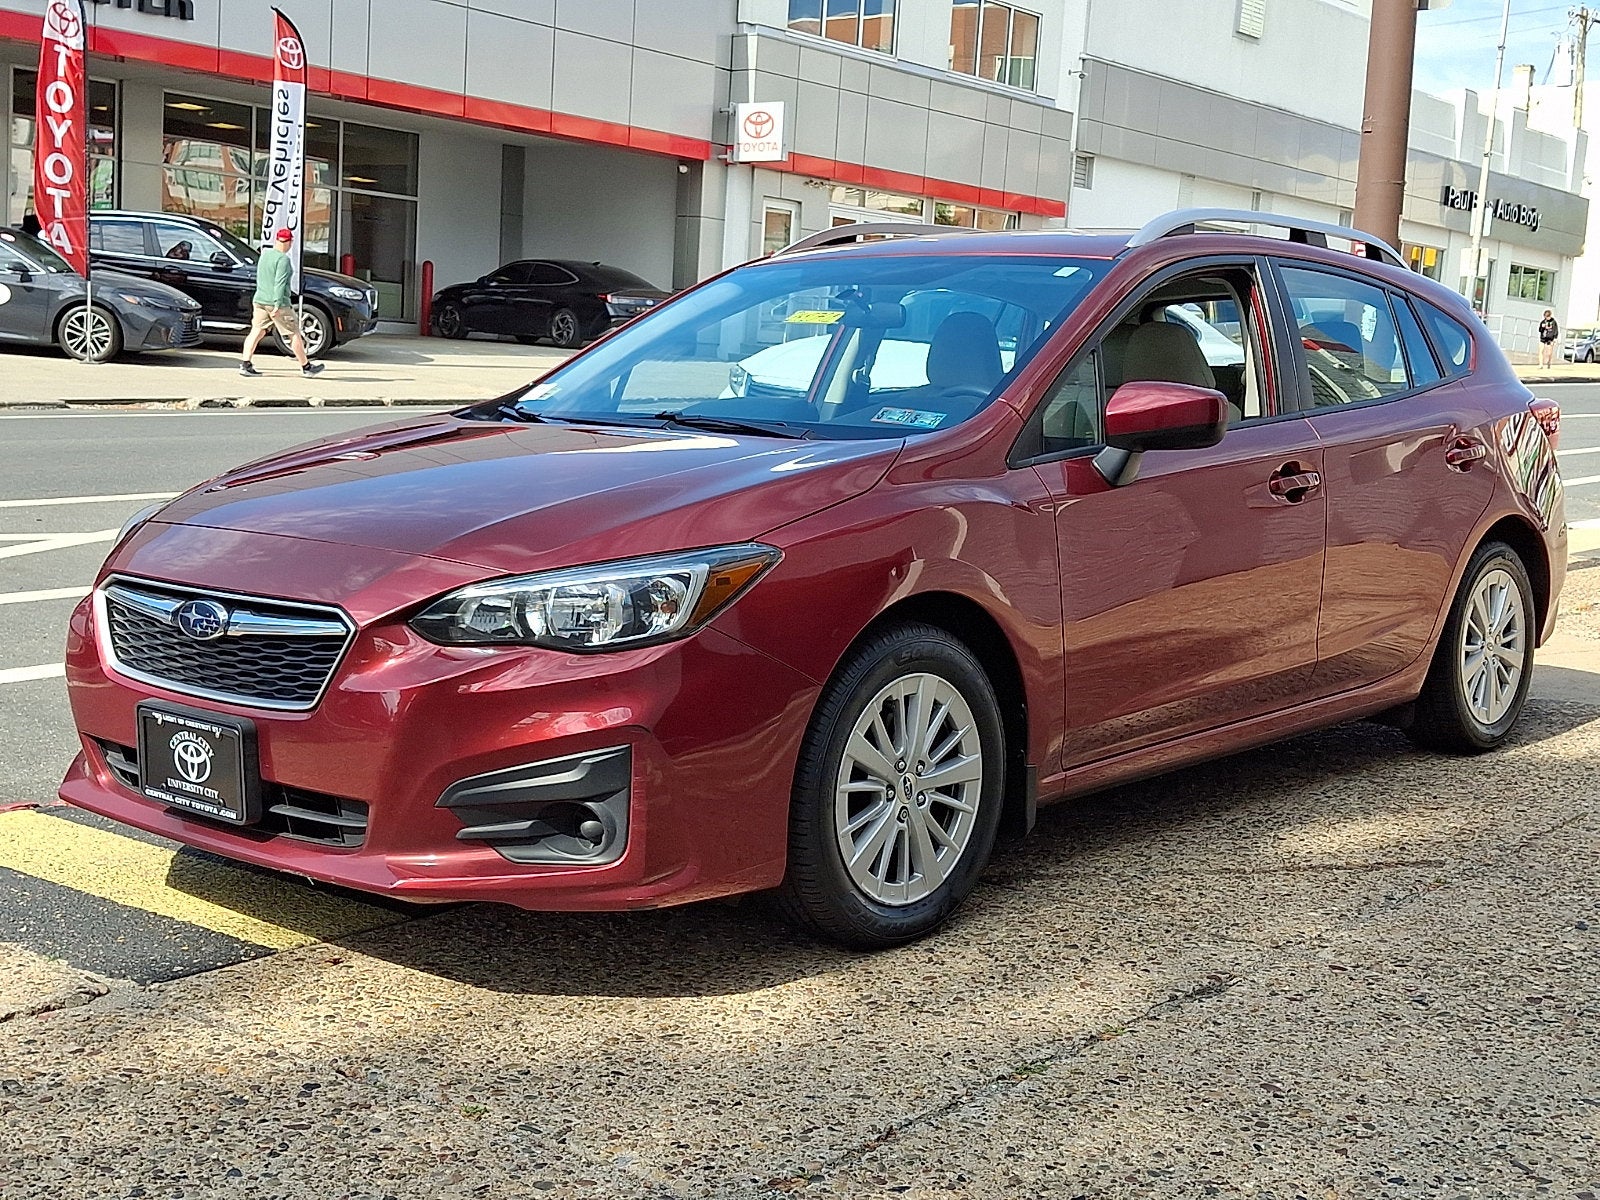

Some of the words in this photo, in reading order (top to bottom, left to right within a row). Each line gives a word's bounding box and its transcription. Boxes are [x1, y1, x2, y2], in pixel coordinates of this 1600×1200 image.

[44, 44, 74, 255] TOYOTA
[737, 141, 778, 153] TOYOTA
[1447, 185, 1471, 211] Paul
[1497, 198, 1518, 222] Auto
[1519, 204, 1543, 233] Body
[169, 731, 197, 750] CENTRAL
[197, 736, 215, 758] CITY
[167, 777, 205, 796] UNIVERSITY
[204, 787, 219, 800] CITY
[145, 788, 175, 803] CENTRAL
[174, 796, 191, 807] CITY
[191, 801, 219, 815] TOYOTA
[219, 809, 237, 820] .COM
